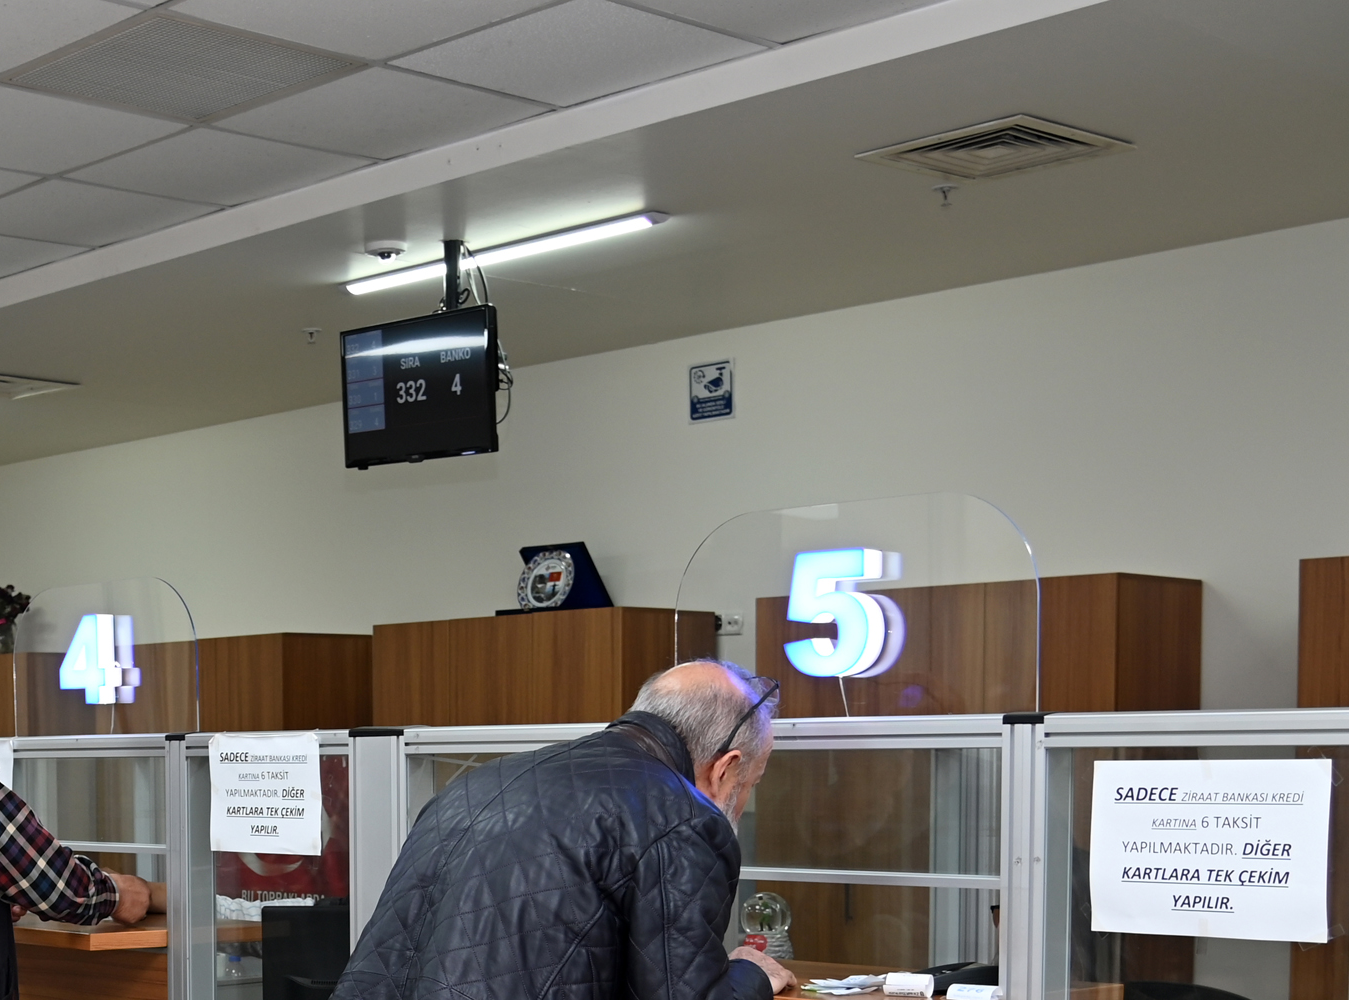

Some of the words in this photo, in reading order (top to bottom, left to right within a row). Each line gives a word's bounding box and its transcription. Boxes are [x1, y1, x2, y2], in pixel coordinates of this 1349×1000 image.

[400, 356, 420, 370] SIRA
[440, 348, 471, 363] BANKO
[396, 378, 427, 404] 332
[451, 373, 462, 396] 4
[783, 547, 886, 678] 5
[59, 613, 122, 705] 4
[220, 752, 249, 762] SADECE
[260, 772, 266, 780] 6
[267, 770, 289, 780] TAKSİT
[282, 786, 305, 798] DİĞER
[1114, 786, 1179, 802] SADECE
[1181, 790, 1220, 802] ZİRAAT
[1222, 792, 1269, 802] BANKASI
[1271, 790, 1304, 802] KREDİ
[226, 806, 264, 816] KARTLARA
[266, 807, 279, 816] TEK
[281, 806, 305, 818] ÇEKİM
[250, 824, 280, 835] YAPILIR.
[1151, 818, 1197, 828] KARTINA
[1200, 816, 1210, 828] 6
[1213, 814, 1262, 829] TAKSİT
[1122, 841, 1238, 856] YAPILMAKTADIR.
[1242, 840, 1292, 857] DİĞER
[1122, 866, 1201, 882] KARTLARA
[1206, 869, 1234, 882] TEK
[1238, 868, 1290, 886] ÇEKİM
[1172, 894, 1234, 910] YAPILIR.
